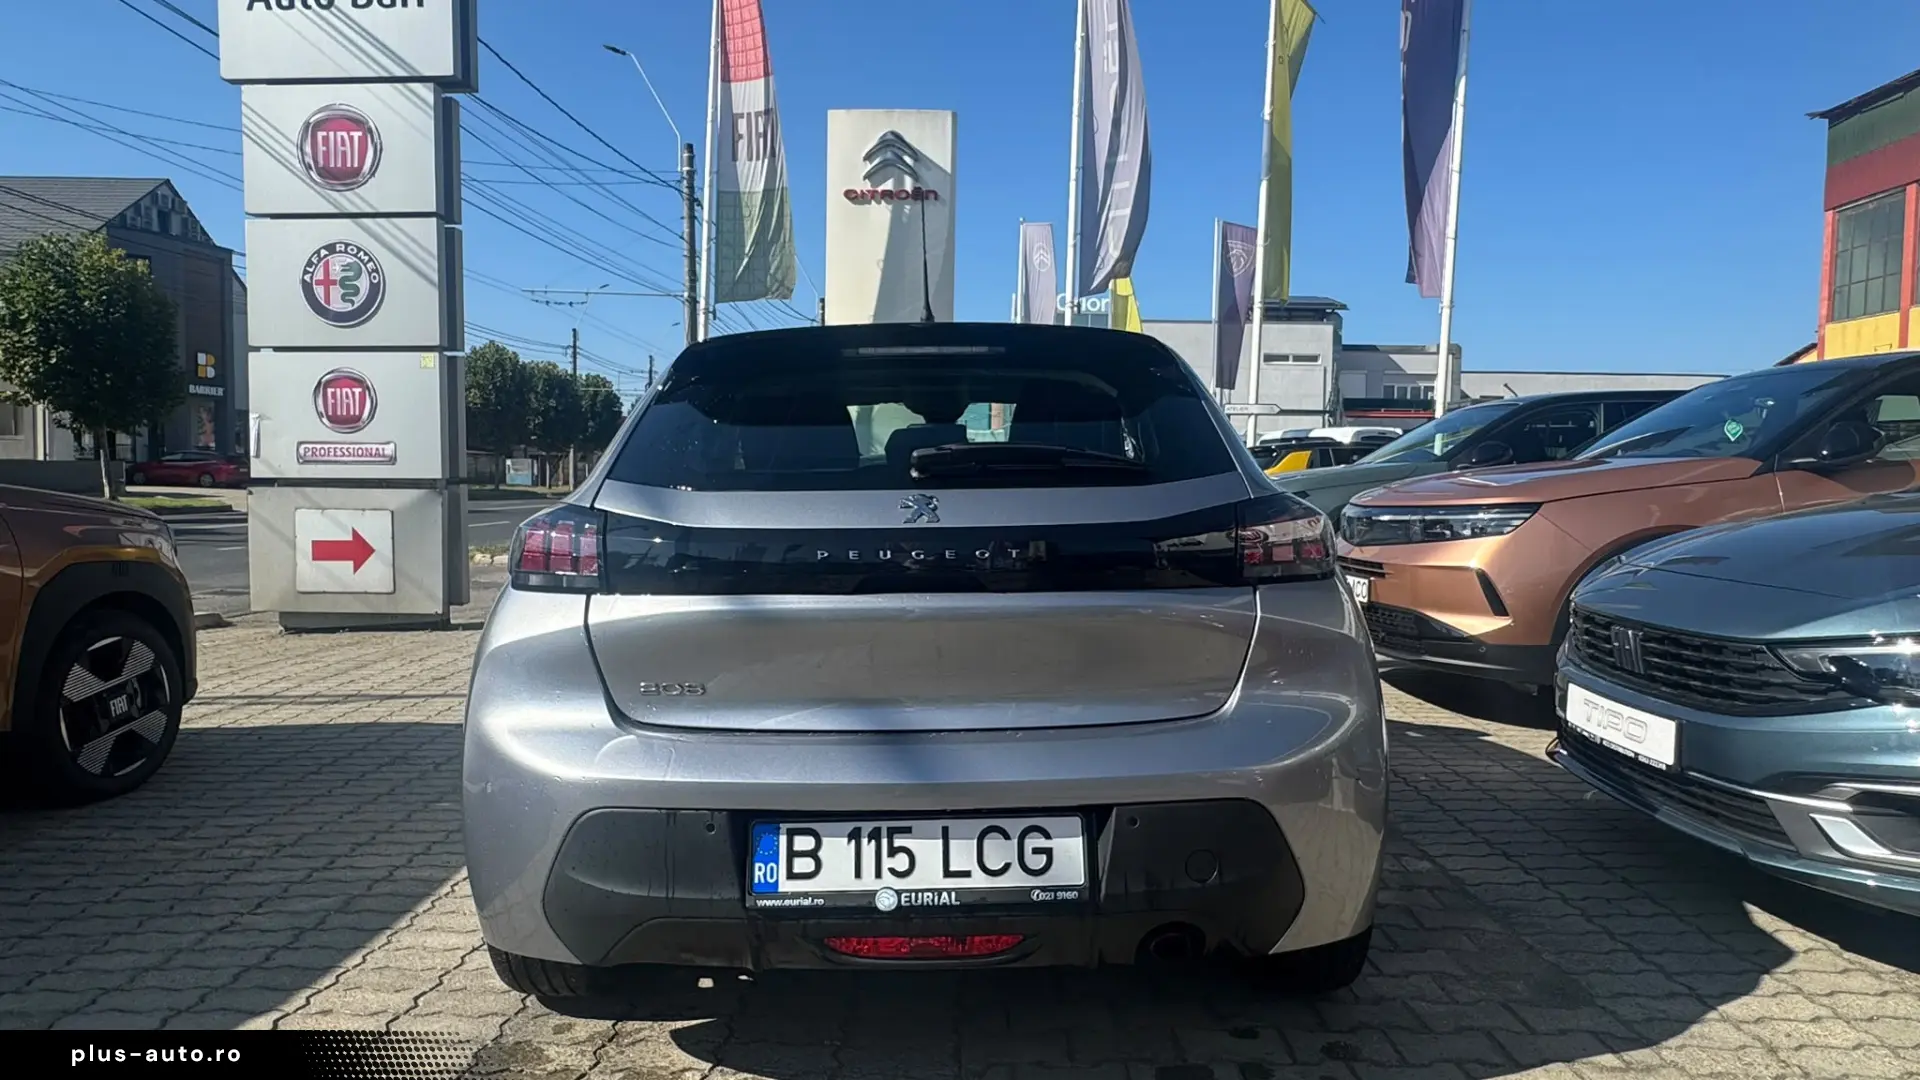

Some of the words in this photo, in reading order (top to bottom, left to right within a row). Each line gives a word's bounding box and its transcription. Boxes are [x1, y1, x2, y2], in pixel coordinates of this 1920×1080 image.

[316, 131, 363, 168] FIAT
[303, 248, 329, 283] ALFA
[336, 243, 380, 284] ROMEO
[326, 388, 362, 415] FIAT
[303, 446, 387, 458] PROFESSIONAL
[816, 548, 1021, 560] PEUGEOT
[109, 695, 129, 717] FIAT
[1584, 698, 1648, 744] TIPO
[785, 827, 823, 881] B
[847, 825, 917, 879] 115
[941, 824, 1054, 879] LCG
[754, 862, 777, 884] RO
[756, 897, 825, 907] www.eurial.ro
